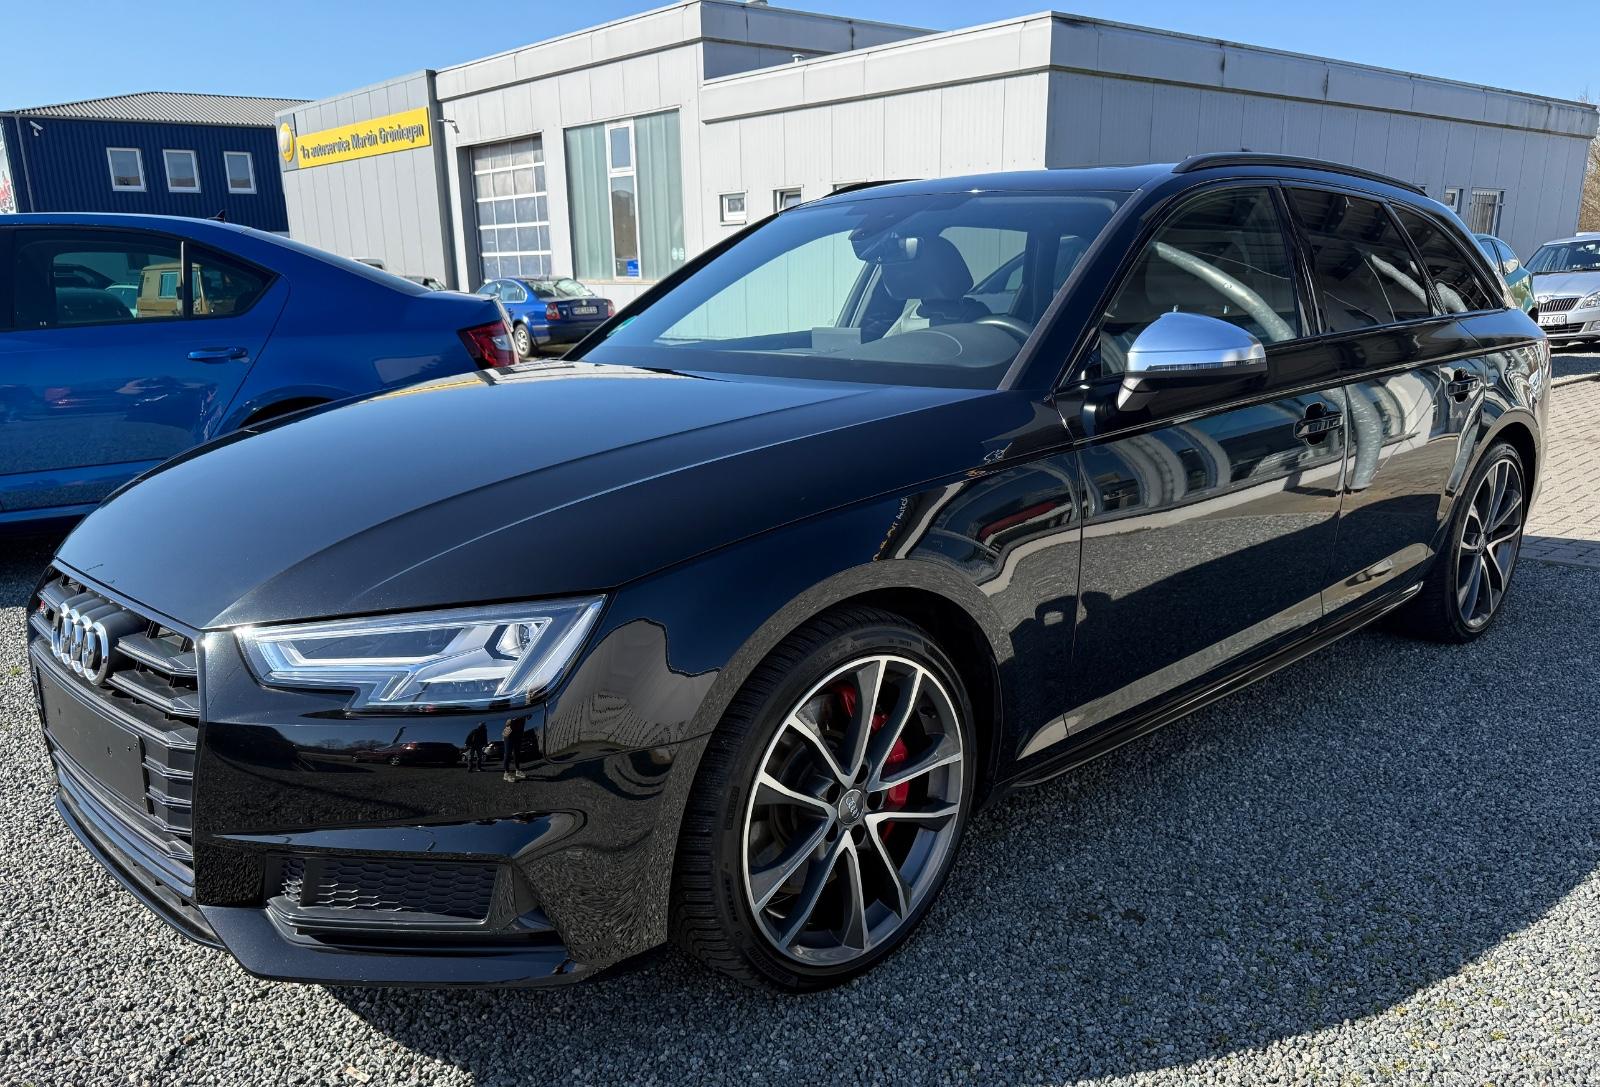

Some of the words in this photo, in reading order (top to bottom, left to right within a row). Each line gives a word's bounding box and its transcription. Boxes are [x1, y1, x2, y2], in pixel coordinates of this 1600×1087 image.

[311, 137, 350, 158] autoservice
[351, 130, 378, 150] Martin
[379, 124, 424, 143] Grönhagen
